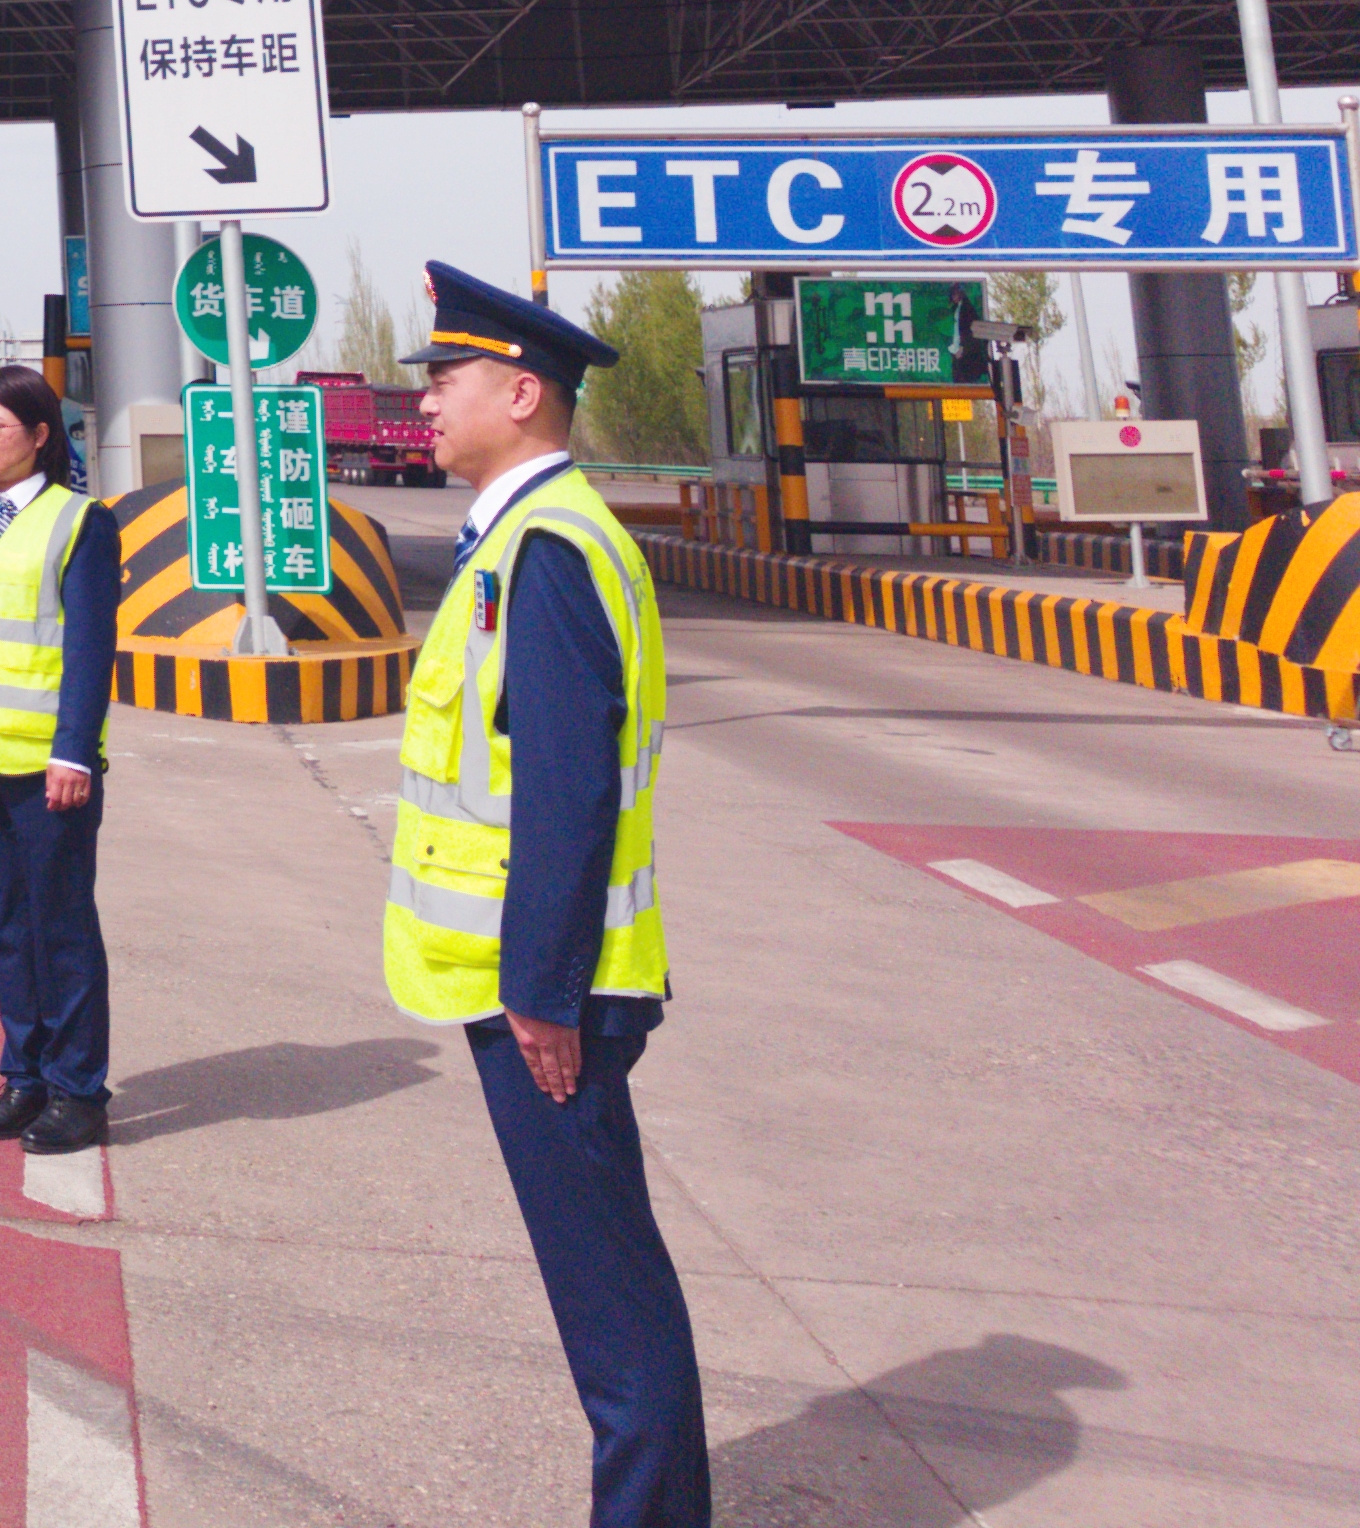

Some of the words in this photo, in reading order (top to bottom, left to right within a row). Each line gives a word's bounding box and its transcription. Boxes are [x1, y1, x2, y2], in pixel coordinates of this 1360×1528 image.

[140, 33, 300, 81] 保持车距
[575, 158, 846, 244] ETC
[910, 181, 981, 217] 2.2m
[1035, 150, 1306, 247] 专用
[276, 399, 317, 580] 谨防砸车
